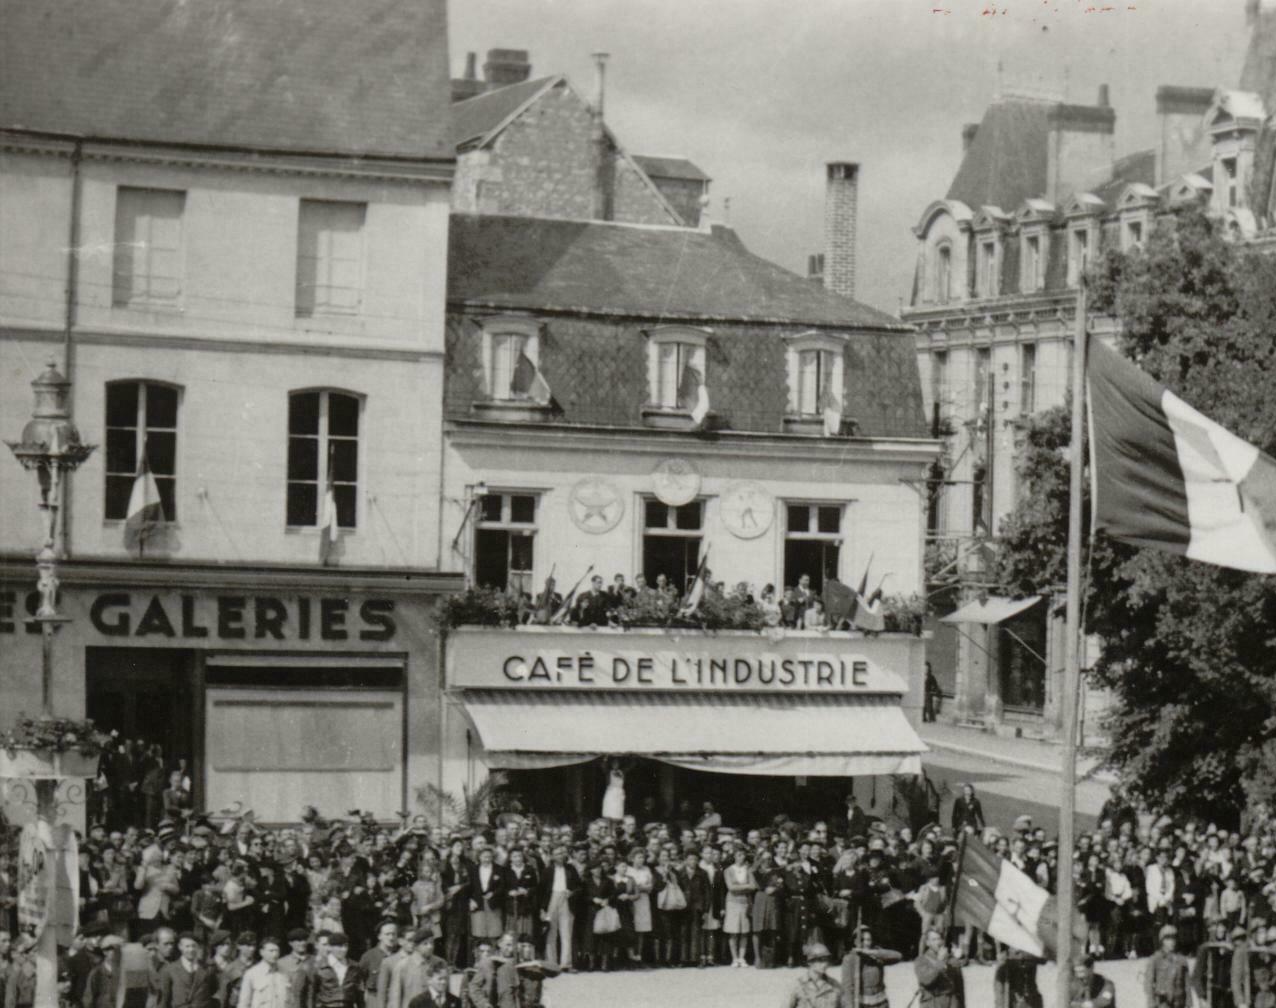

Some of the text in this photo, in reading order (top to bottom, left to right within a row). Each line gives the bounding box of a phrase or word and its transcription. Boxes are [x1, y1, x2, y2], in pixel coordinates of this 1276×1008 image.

[90, 593, 396, 641] GALERIES
[503, 652, 868, 686] CAFÉ DE L'INDUSTRIE
